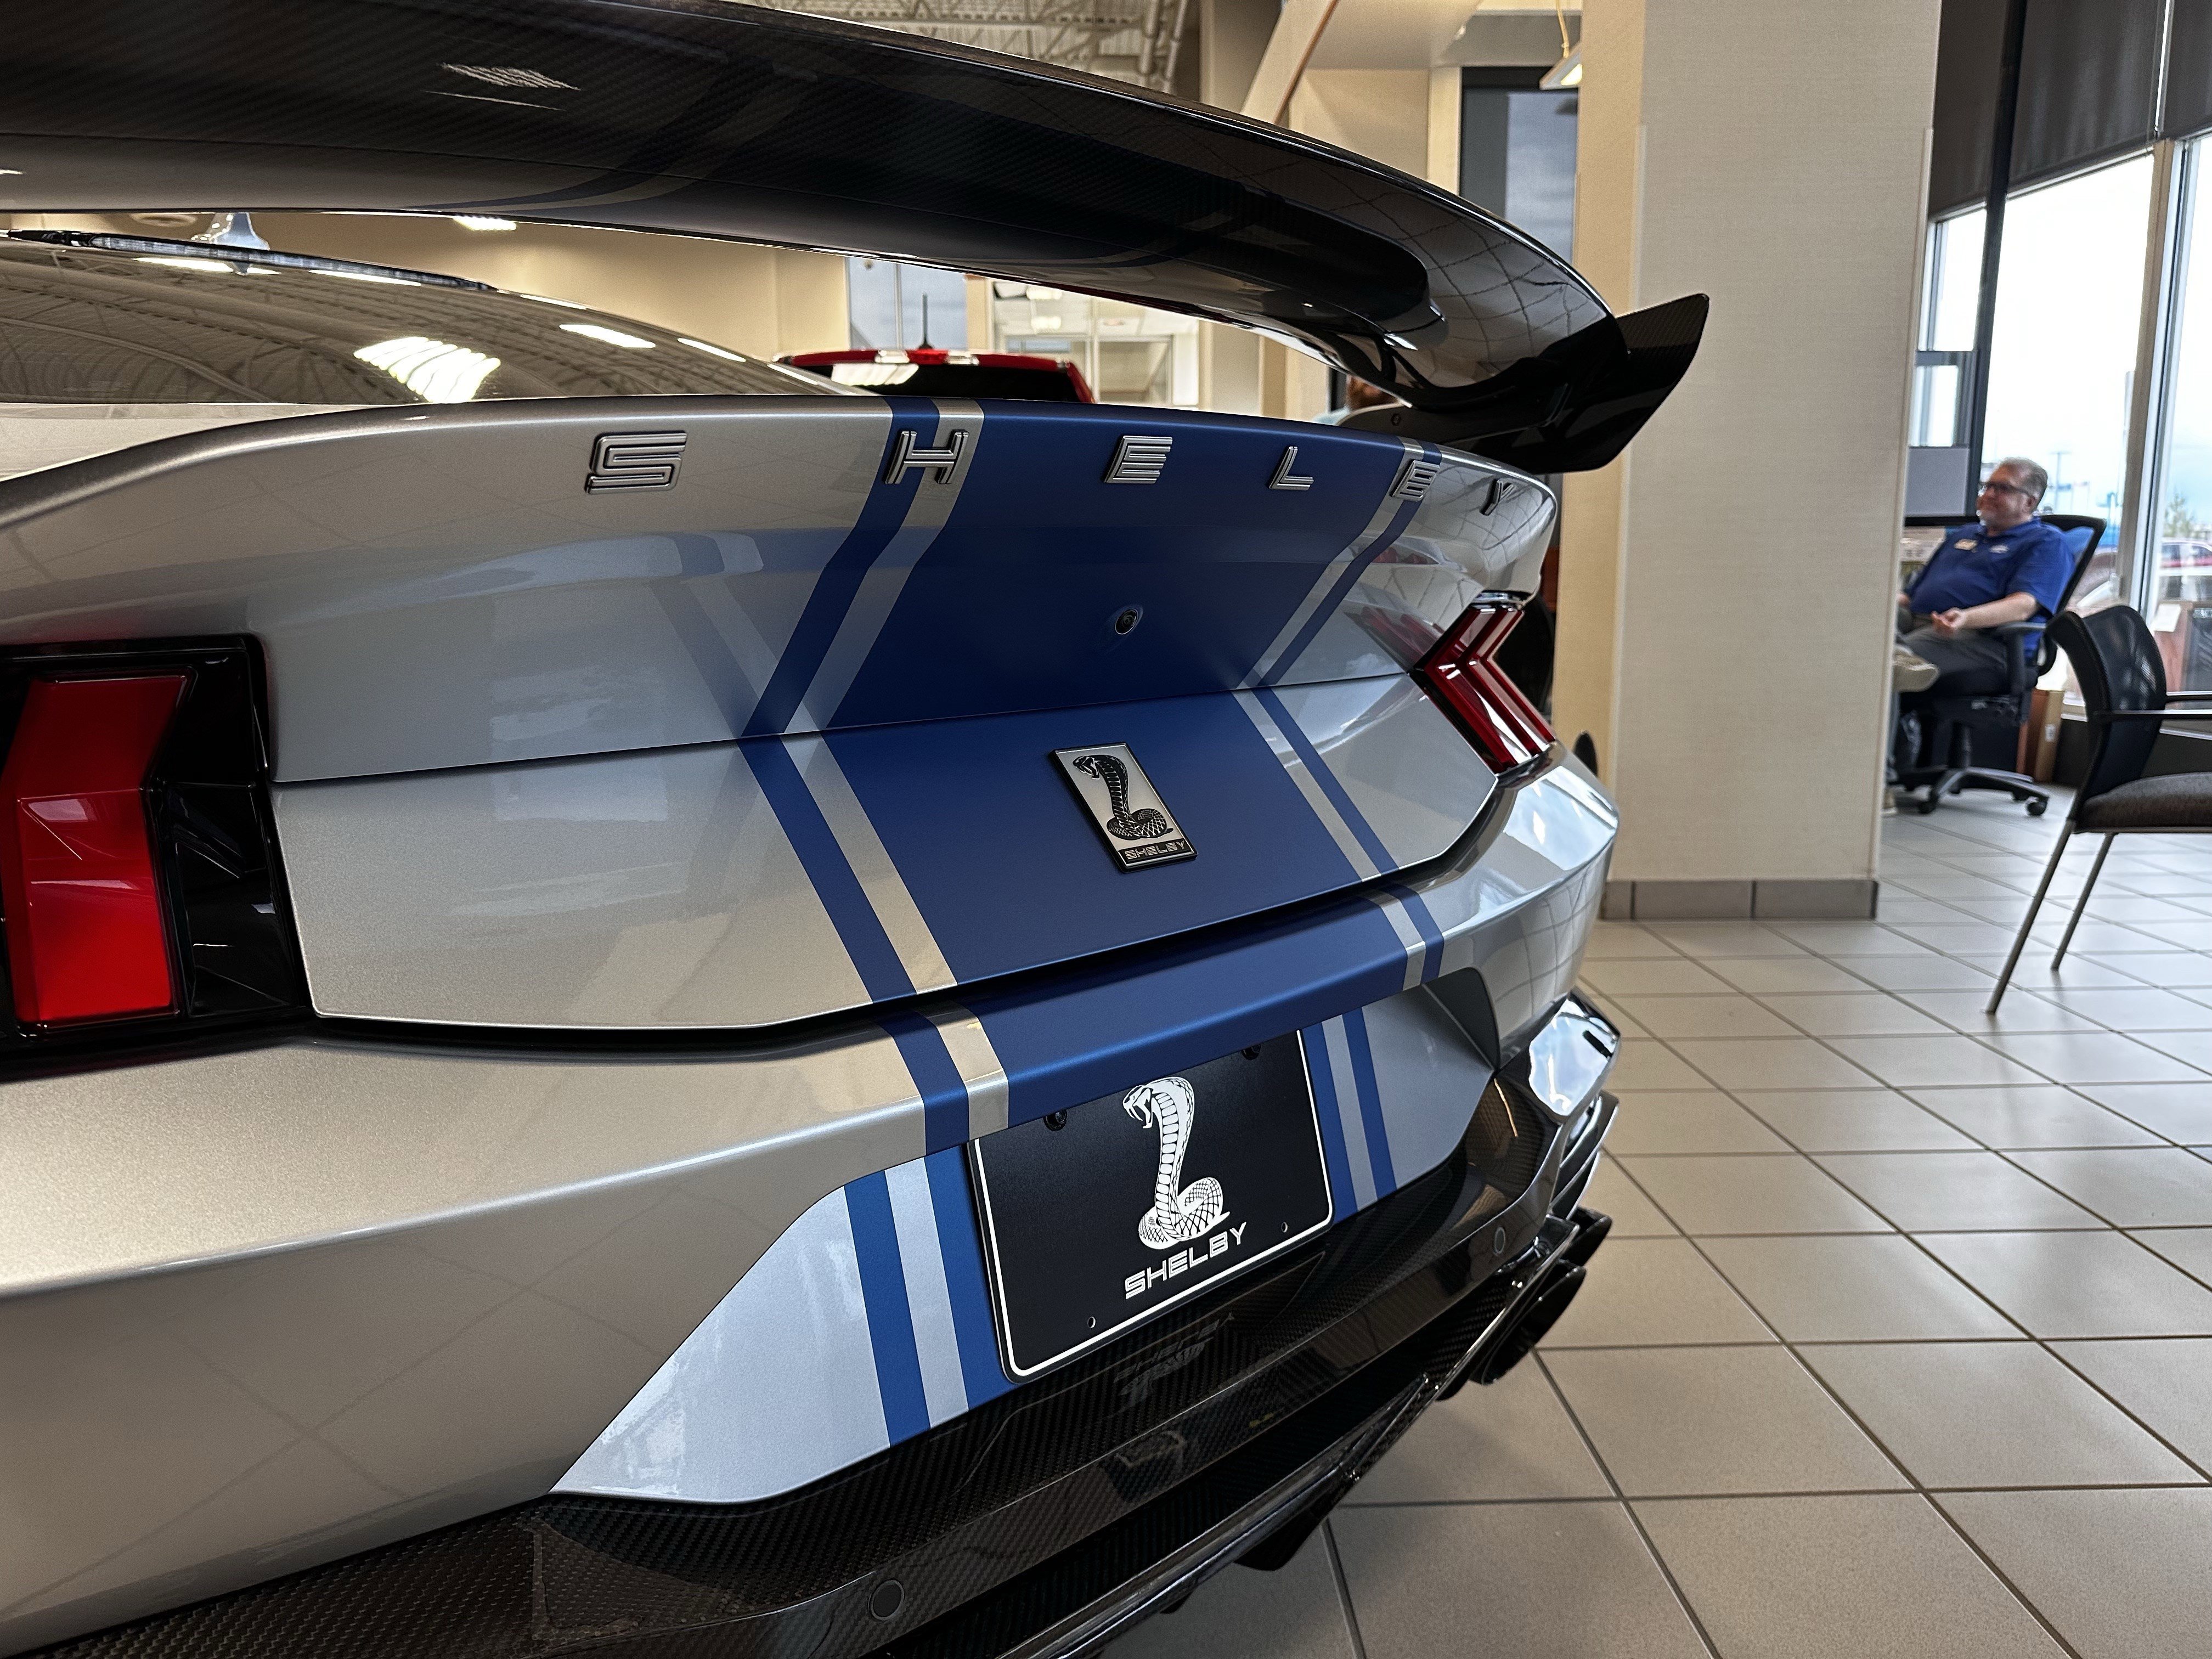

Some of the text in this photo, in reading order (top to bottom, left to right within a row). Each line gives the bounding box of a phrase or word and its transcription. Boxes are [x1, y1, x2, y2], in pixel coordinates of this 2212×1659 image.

[585, 430, 1515, 516] SHELBY
[1125, 840, 1184, 859] SHELBY
[1125, 1222, 1246, 1299] SHELBY
